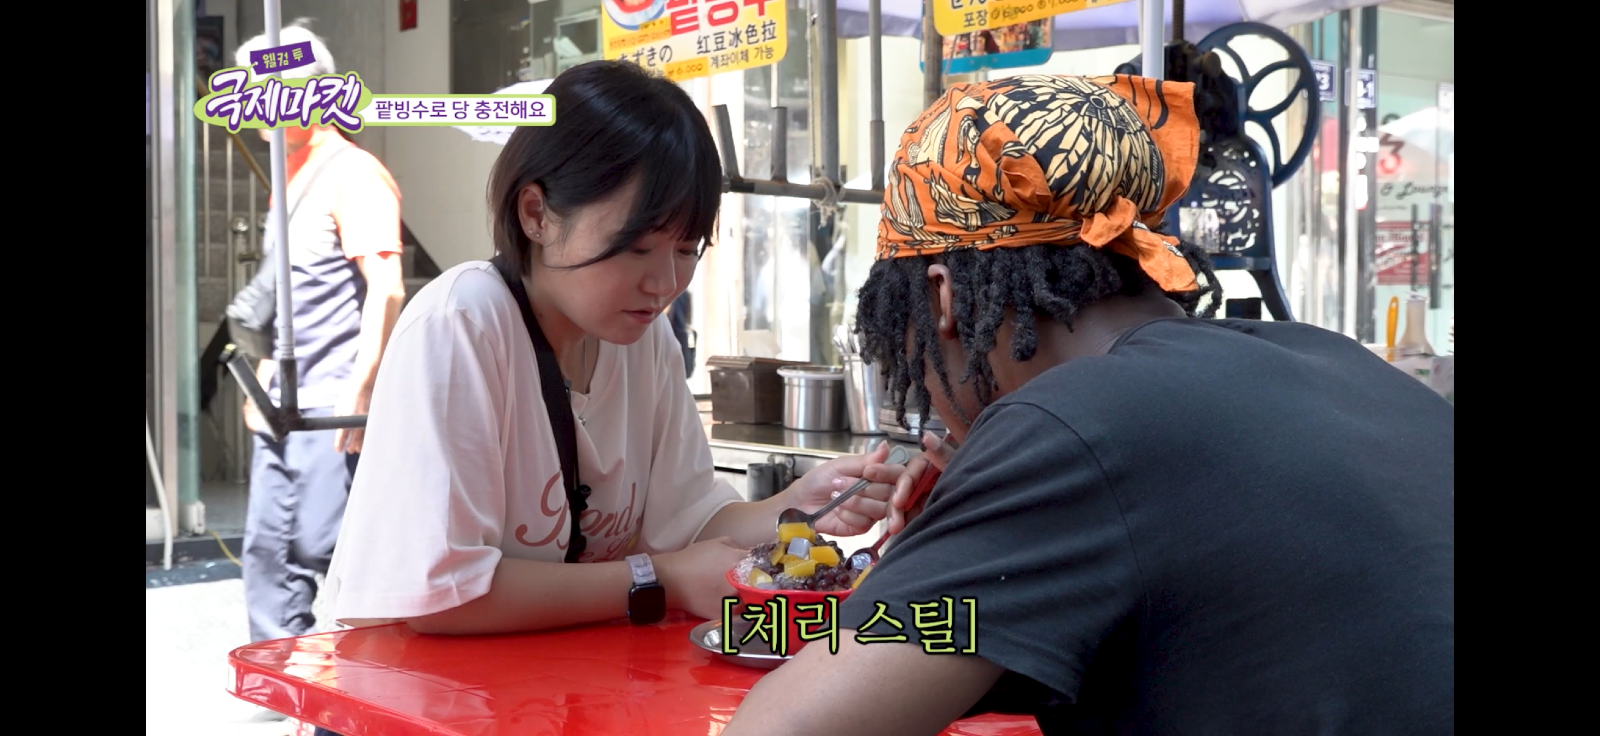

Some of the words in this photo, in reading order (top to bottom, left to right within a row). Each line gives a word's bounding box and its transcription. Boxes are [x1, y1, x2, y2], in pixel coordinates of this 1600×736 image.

[964, 9, 988, 28] 포장
[696, 19, 777, 55] 红豆冰色拉
[711, 49, 749, 68] 계좌이체
[754, 45, 775, 60] 가능
